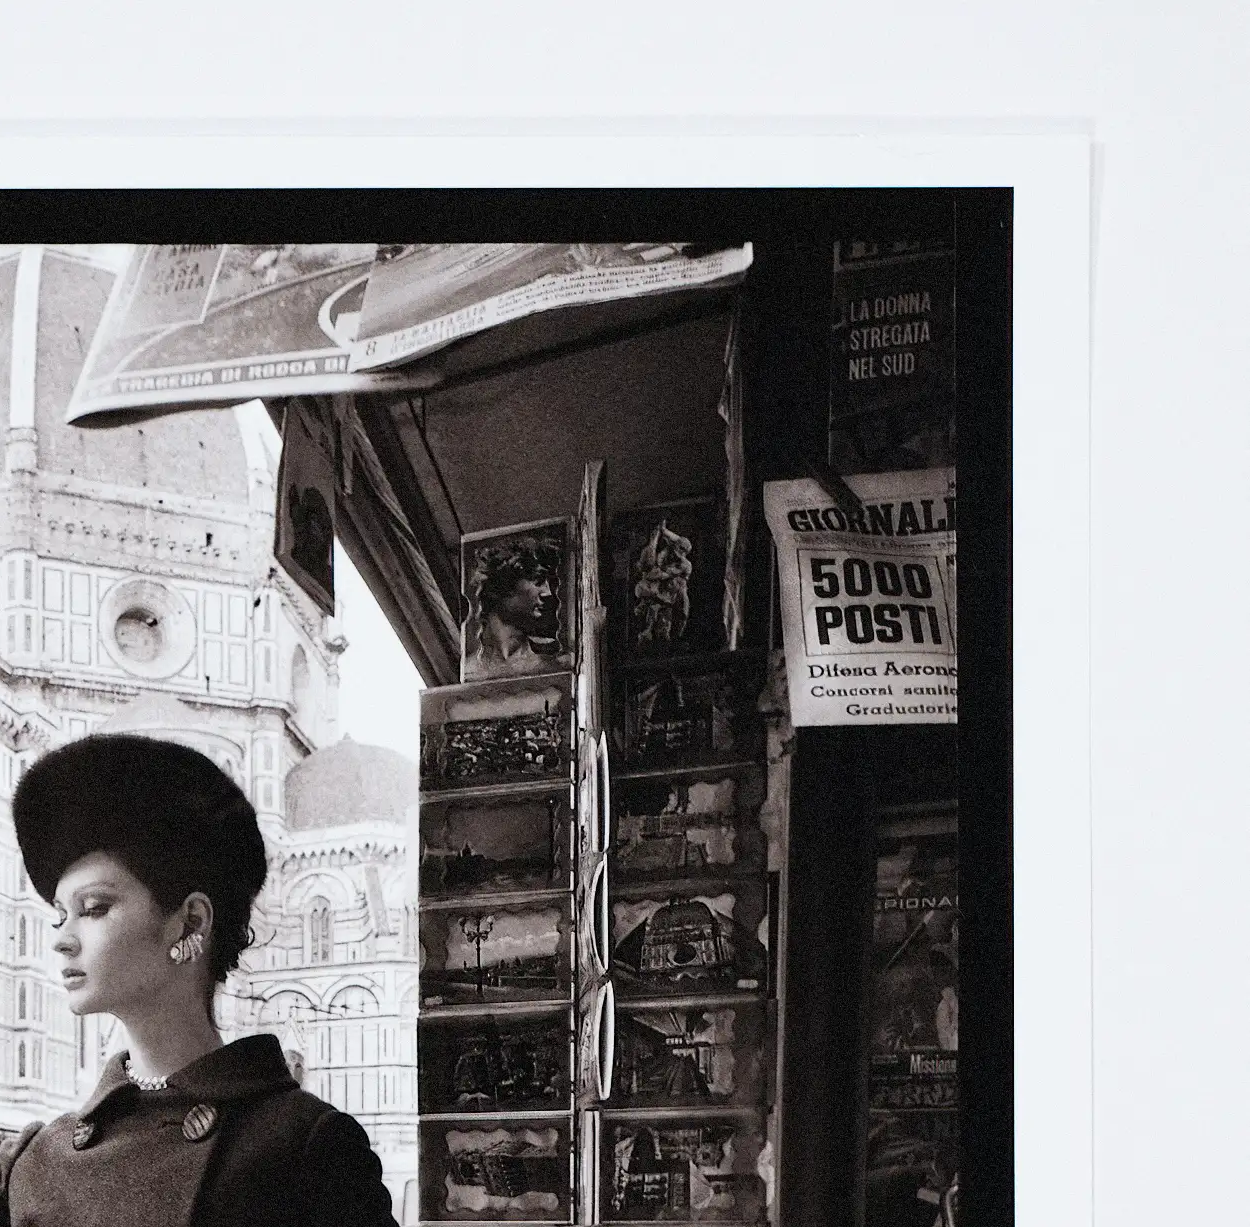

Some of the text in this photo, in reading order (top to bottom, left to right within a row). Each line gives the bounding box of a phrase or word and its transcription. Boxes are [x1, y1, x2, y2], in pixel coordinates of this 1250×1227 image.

[850, 292, 931, 322] LA DONNA
[850, 322, 930, 351] STREGATA
[221, 367, 241, 383] DI
[849, 353, 915, 380] NEL SUD
[811, 558, 932, 598] 5000
[815, 603, 942, 645] POSTI
[807, 662, 877, 679] Difesa
[811, 684, 893, 698] Concorsi
